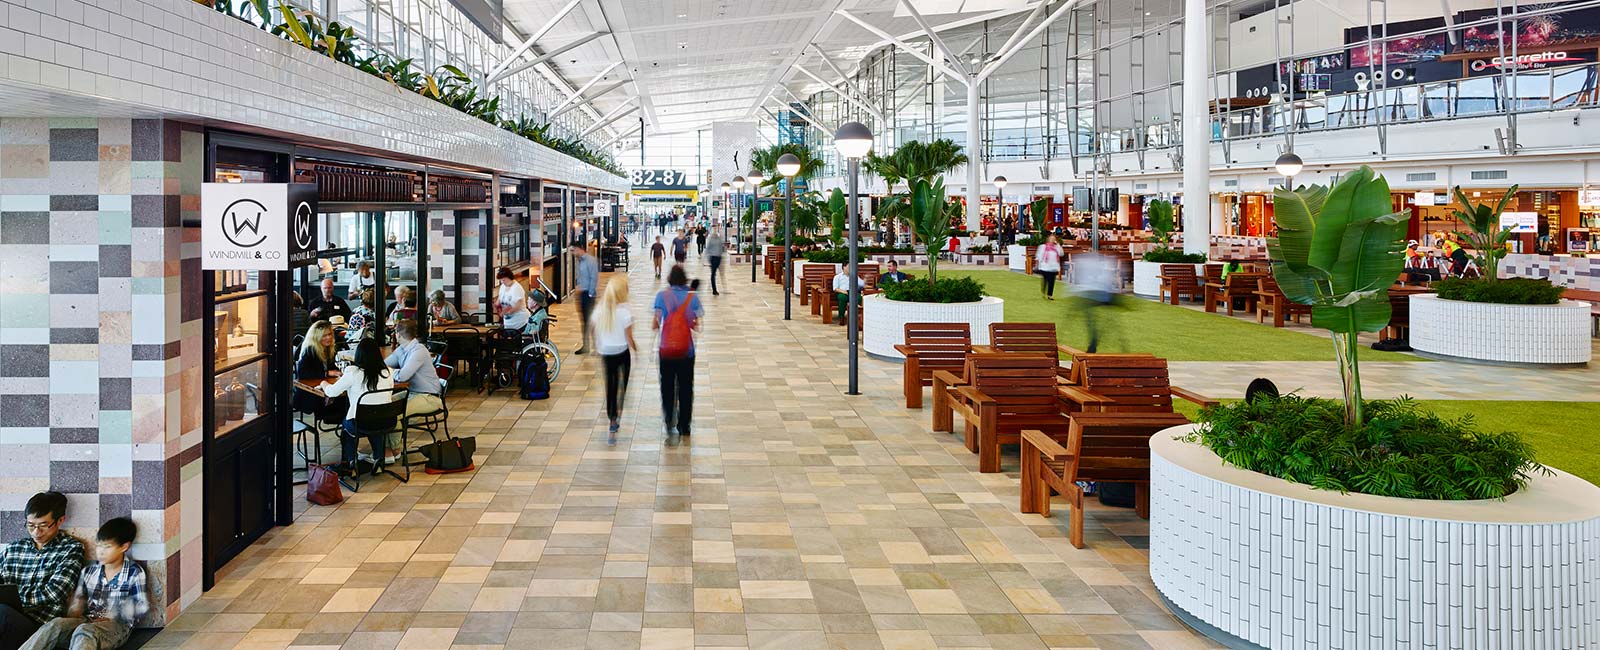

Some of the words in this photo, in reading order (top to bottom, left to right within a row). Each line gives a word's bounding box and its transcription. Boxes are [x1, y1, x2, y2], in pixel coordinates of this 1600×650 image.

[632, 169, 686, 186] 82-87
[209, 250, 252, 259] WINDMILL
[254, 250, 262, 259] &
[265, 250, 281, 260] CO
